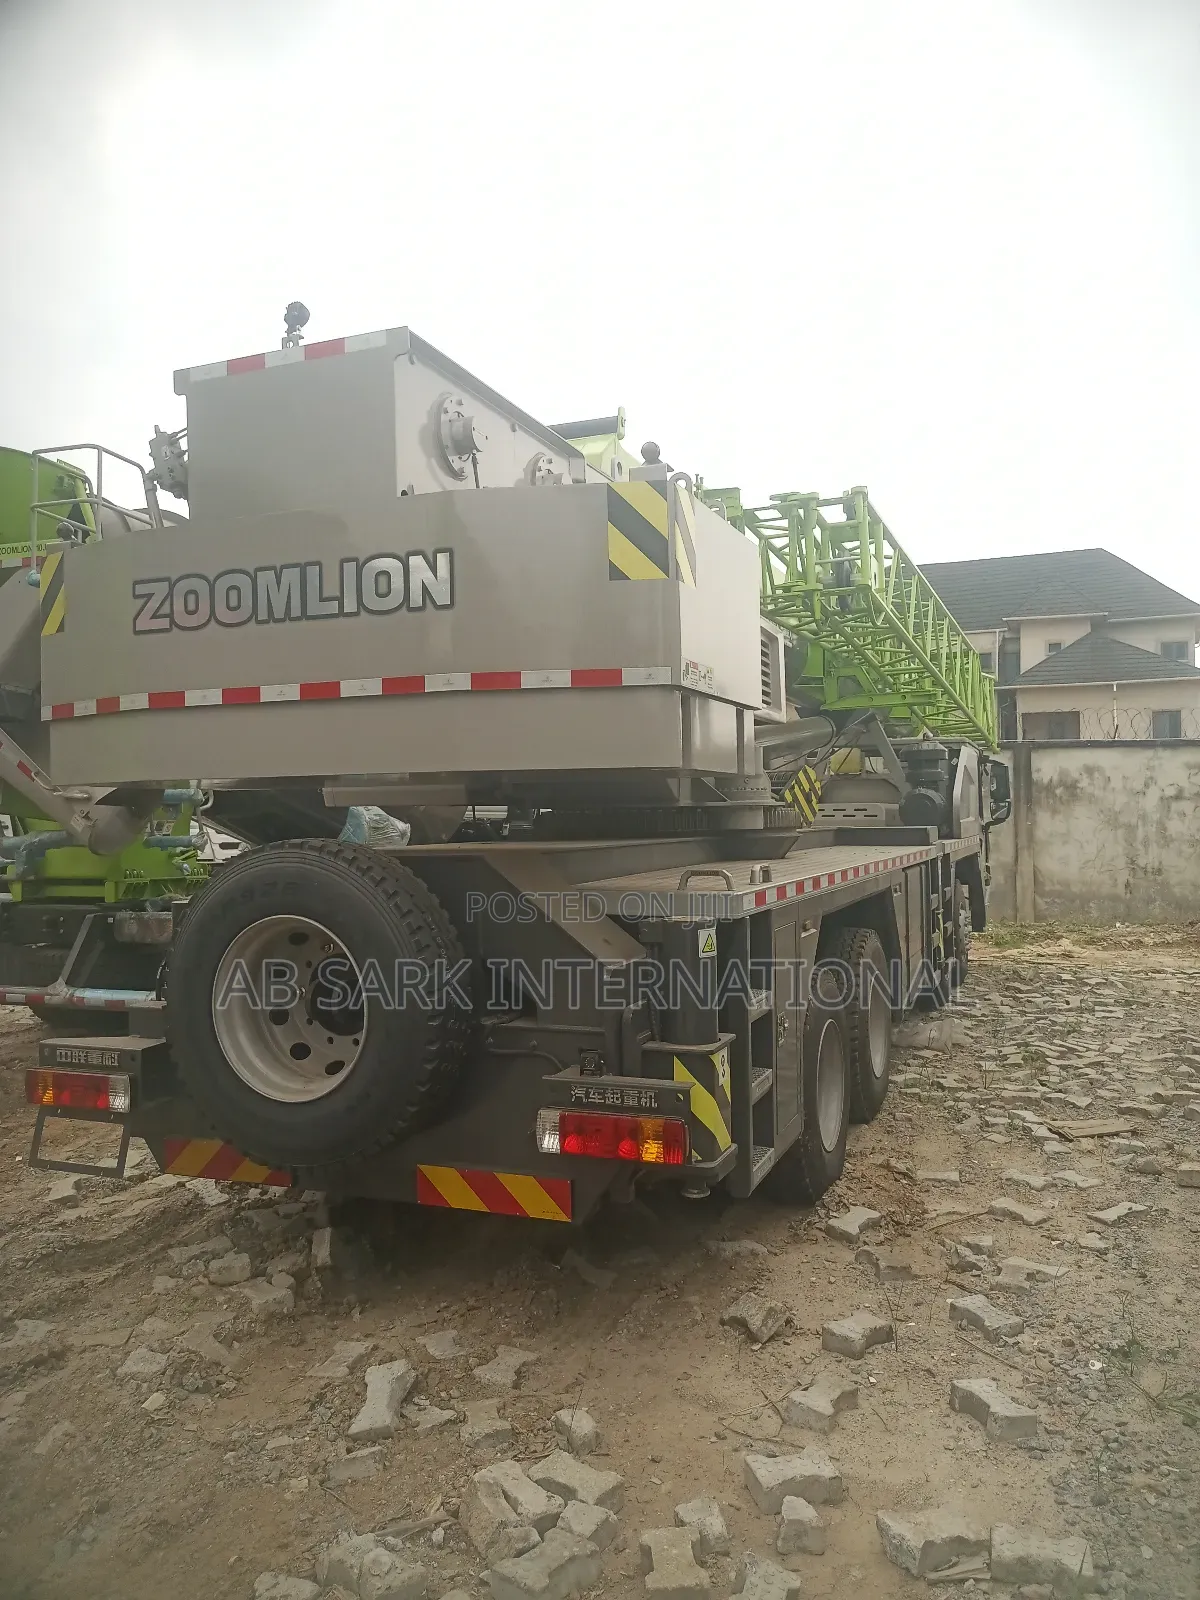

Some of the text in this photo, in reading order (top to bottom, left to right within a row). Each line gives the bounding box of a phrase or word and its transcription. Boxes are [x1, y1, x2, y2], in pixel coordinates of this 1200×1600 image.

[133, 548, 453, 634] ZOOMLION
[571, 1085, 658, 1108] 汽车起重机
